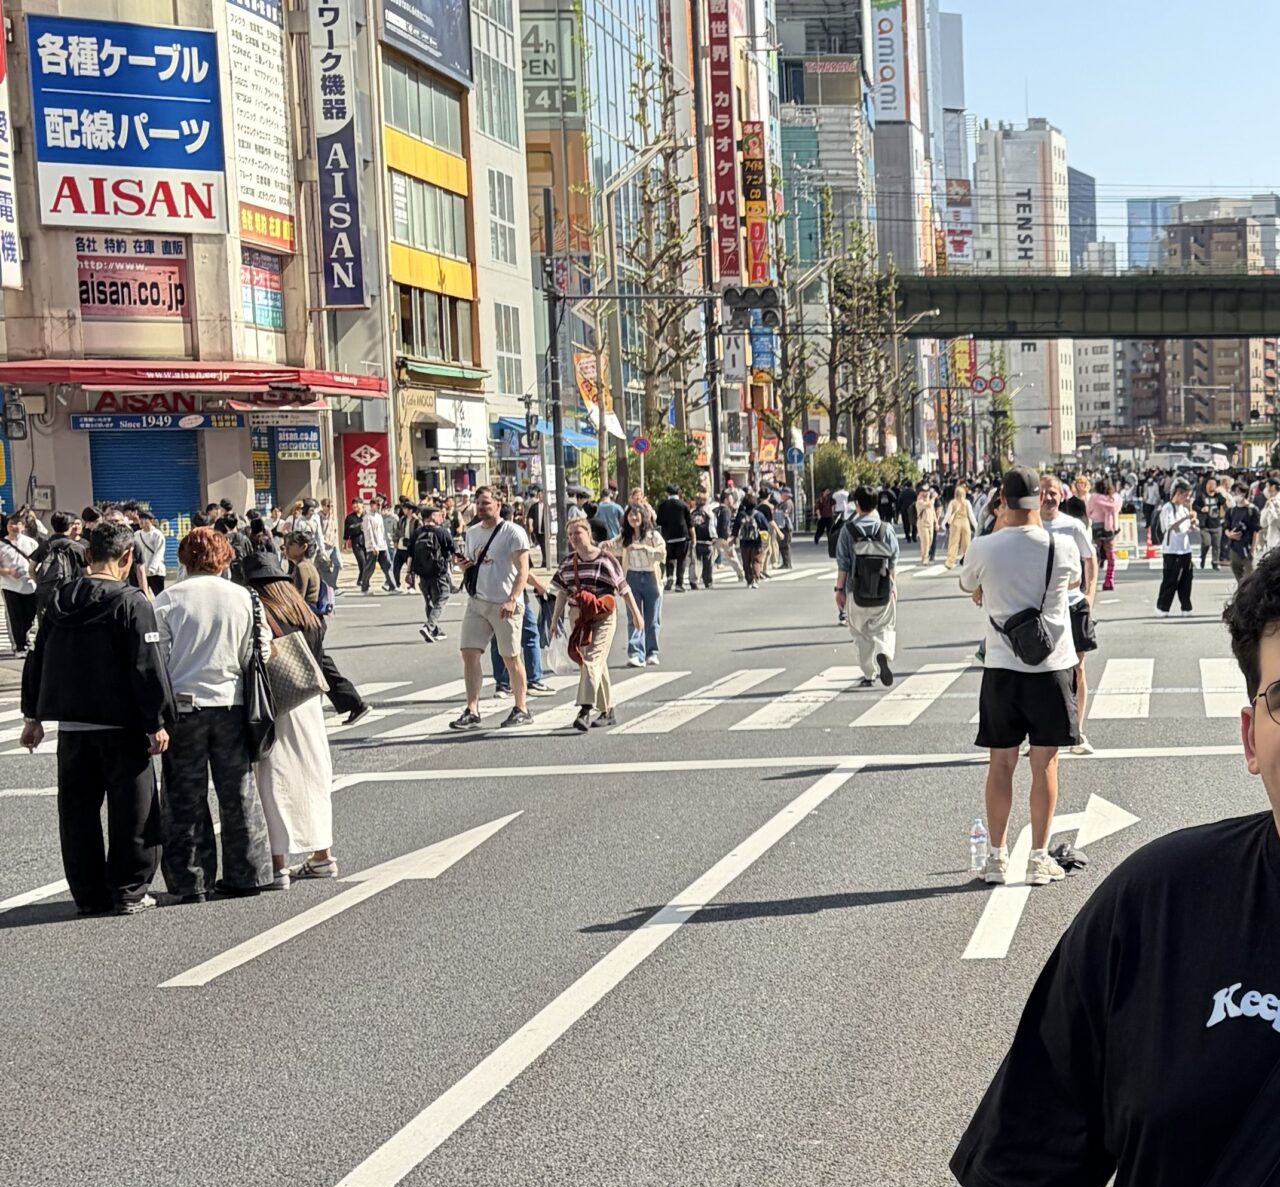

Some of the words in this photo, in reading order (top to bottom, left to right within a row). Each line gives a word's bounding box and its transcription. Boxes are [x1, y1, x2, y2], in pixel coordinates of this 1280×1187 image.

[36, 32, 209, 84] 各種ケーブル
[318, 0, 347, 120] ワーク機器
[877, 17, 898, 112] amiami
[44, 107, 210, 154] 配線パーツ
[50, 175, 216, 219] AISAN
[325, 142, 355, 289] AISAN
[76, 237, 97, 252] 各社
[105, 238, 127, 253] 特約
[132, 239, 155, 254] 在庫
[162, 240, 183, 255] 直販
[79, 273, 184, 311] aisan.co.jp
[94, 391, 196, 412] AISAN
[119, 420, 141, 428] Since
[141, 415, 172, 428] 1949
